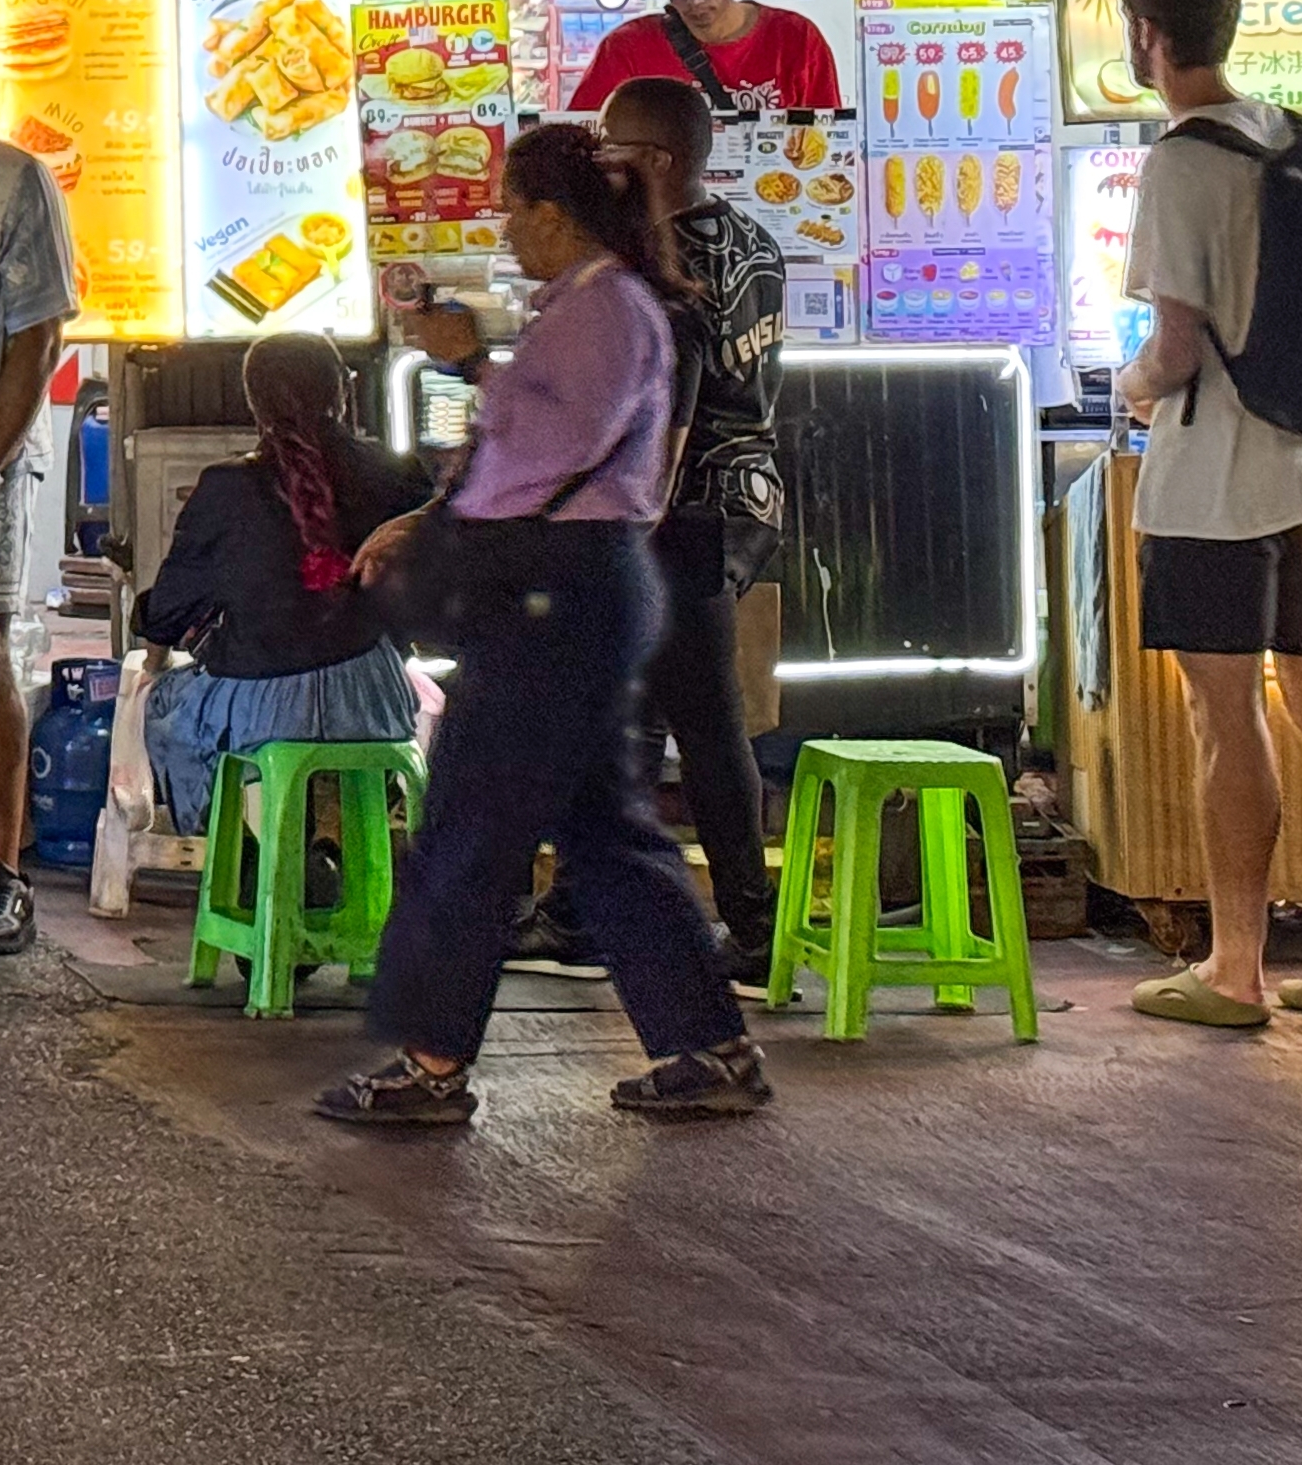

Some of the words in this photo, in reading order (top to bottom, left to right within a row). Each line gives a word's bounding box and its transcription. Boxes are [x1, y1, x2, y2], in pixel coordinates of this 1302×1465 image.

[368, 2, 497, 30] HAMBURGER
[907, 19, 986, 36] Corndog
[44, 102, 85, 134] Milo
[194, 217, 250, 253] Vegan
